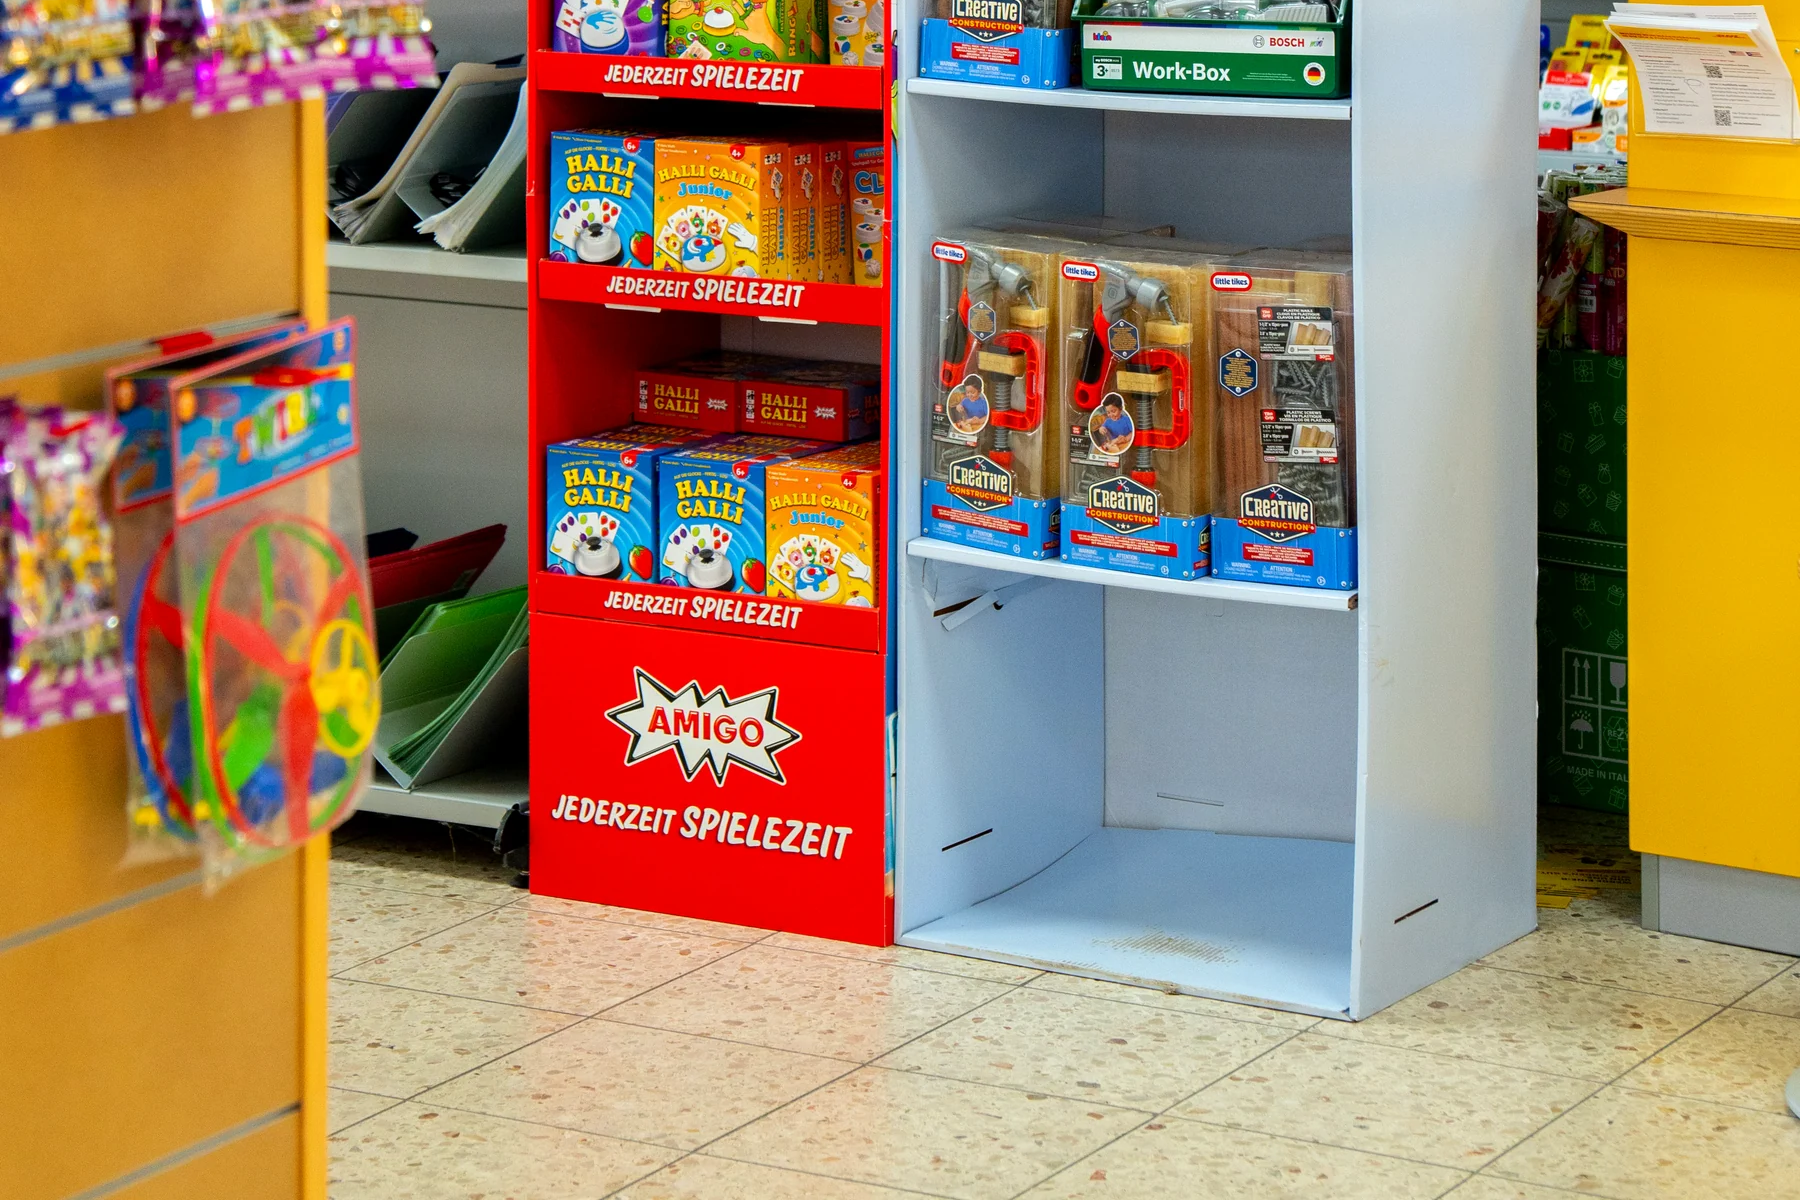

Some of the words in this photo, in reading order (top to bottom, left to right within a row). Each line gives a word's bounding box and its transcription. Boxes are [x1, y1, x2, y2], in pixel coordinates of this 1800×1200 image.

[952, 18, 1018, 32] CONSTRUCTION
[1269, 37, 1305, 48] BOSCH
[604, 64, 689, 86] JEDERZEIT
[690, 64, 804, 92] SPIELEZEIT
[1097, 65, 1109, 77] 3+
[1132, 60, 1231, 82] Work-Box
[626, 142, 636, 150] 6+
[731, 150, 742, 158] 4+
[566, 154, 637, 179] HALLI
[567, 174, 634, 199] GALLI
[658, 164, 706, 183] HALLI
[708, 165, 756, 192] GALLI
[677, 182, 732, 200] Junior
[935, 246, 949, 256] little
[949, 248, 964, 260] tikes
[1066, 265, 1080, 275] little
[1080, 267, 1096, 278] tikes
[1214, 277, 1230, 286] little
[1230, 277, 1248, 286] tikes
[606, 275, 690, 299] JEDERZEIT
[692, 277, 805, 308] SPIELEZEIT
[654, 383, 700, 400] HALLI
[654, 397, 699, 414] GALLI
[761, 392, 807, 410] HALLI
[761, 406, 807, 423] GALLI
[624, 456, 633, 465] 6+
[563, 467, 634, 493] HALLI
[735, 468, 745, 476] 6+
[675, 479, 746, 505] HALLI
[843, 479, 853, 487] 4+
[564, 487, 632, 512] GALLI
[949, 485, 1010, 503] CONSTRUCTION
[676, 499, 744, 524] GALLI
[770, 494, 818, 512] HALLI
[820, 495, 869, 521] GALLI
[1089, 508, 1156, 524] CONSTRUCTION
[789, 510, 845, 530] Junior
[1241, 517, 1311, 532] CONSTRUCTION
[604, 591, 688, 617] JEDERZEIT
[690, 596, 803, 630] SPIELEZEIT
[647, 705, 764, 748] AMIGO
[1567, 766, 1594, 778] MADE
[1596, 770, 1606, 779] IN
[1608, 772, 1628, 783] ITAL
[552, 794, 677, 835] JEDERZEIT
[679, 805, 853, 860] SPIELEZEIT
